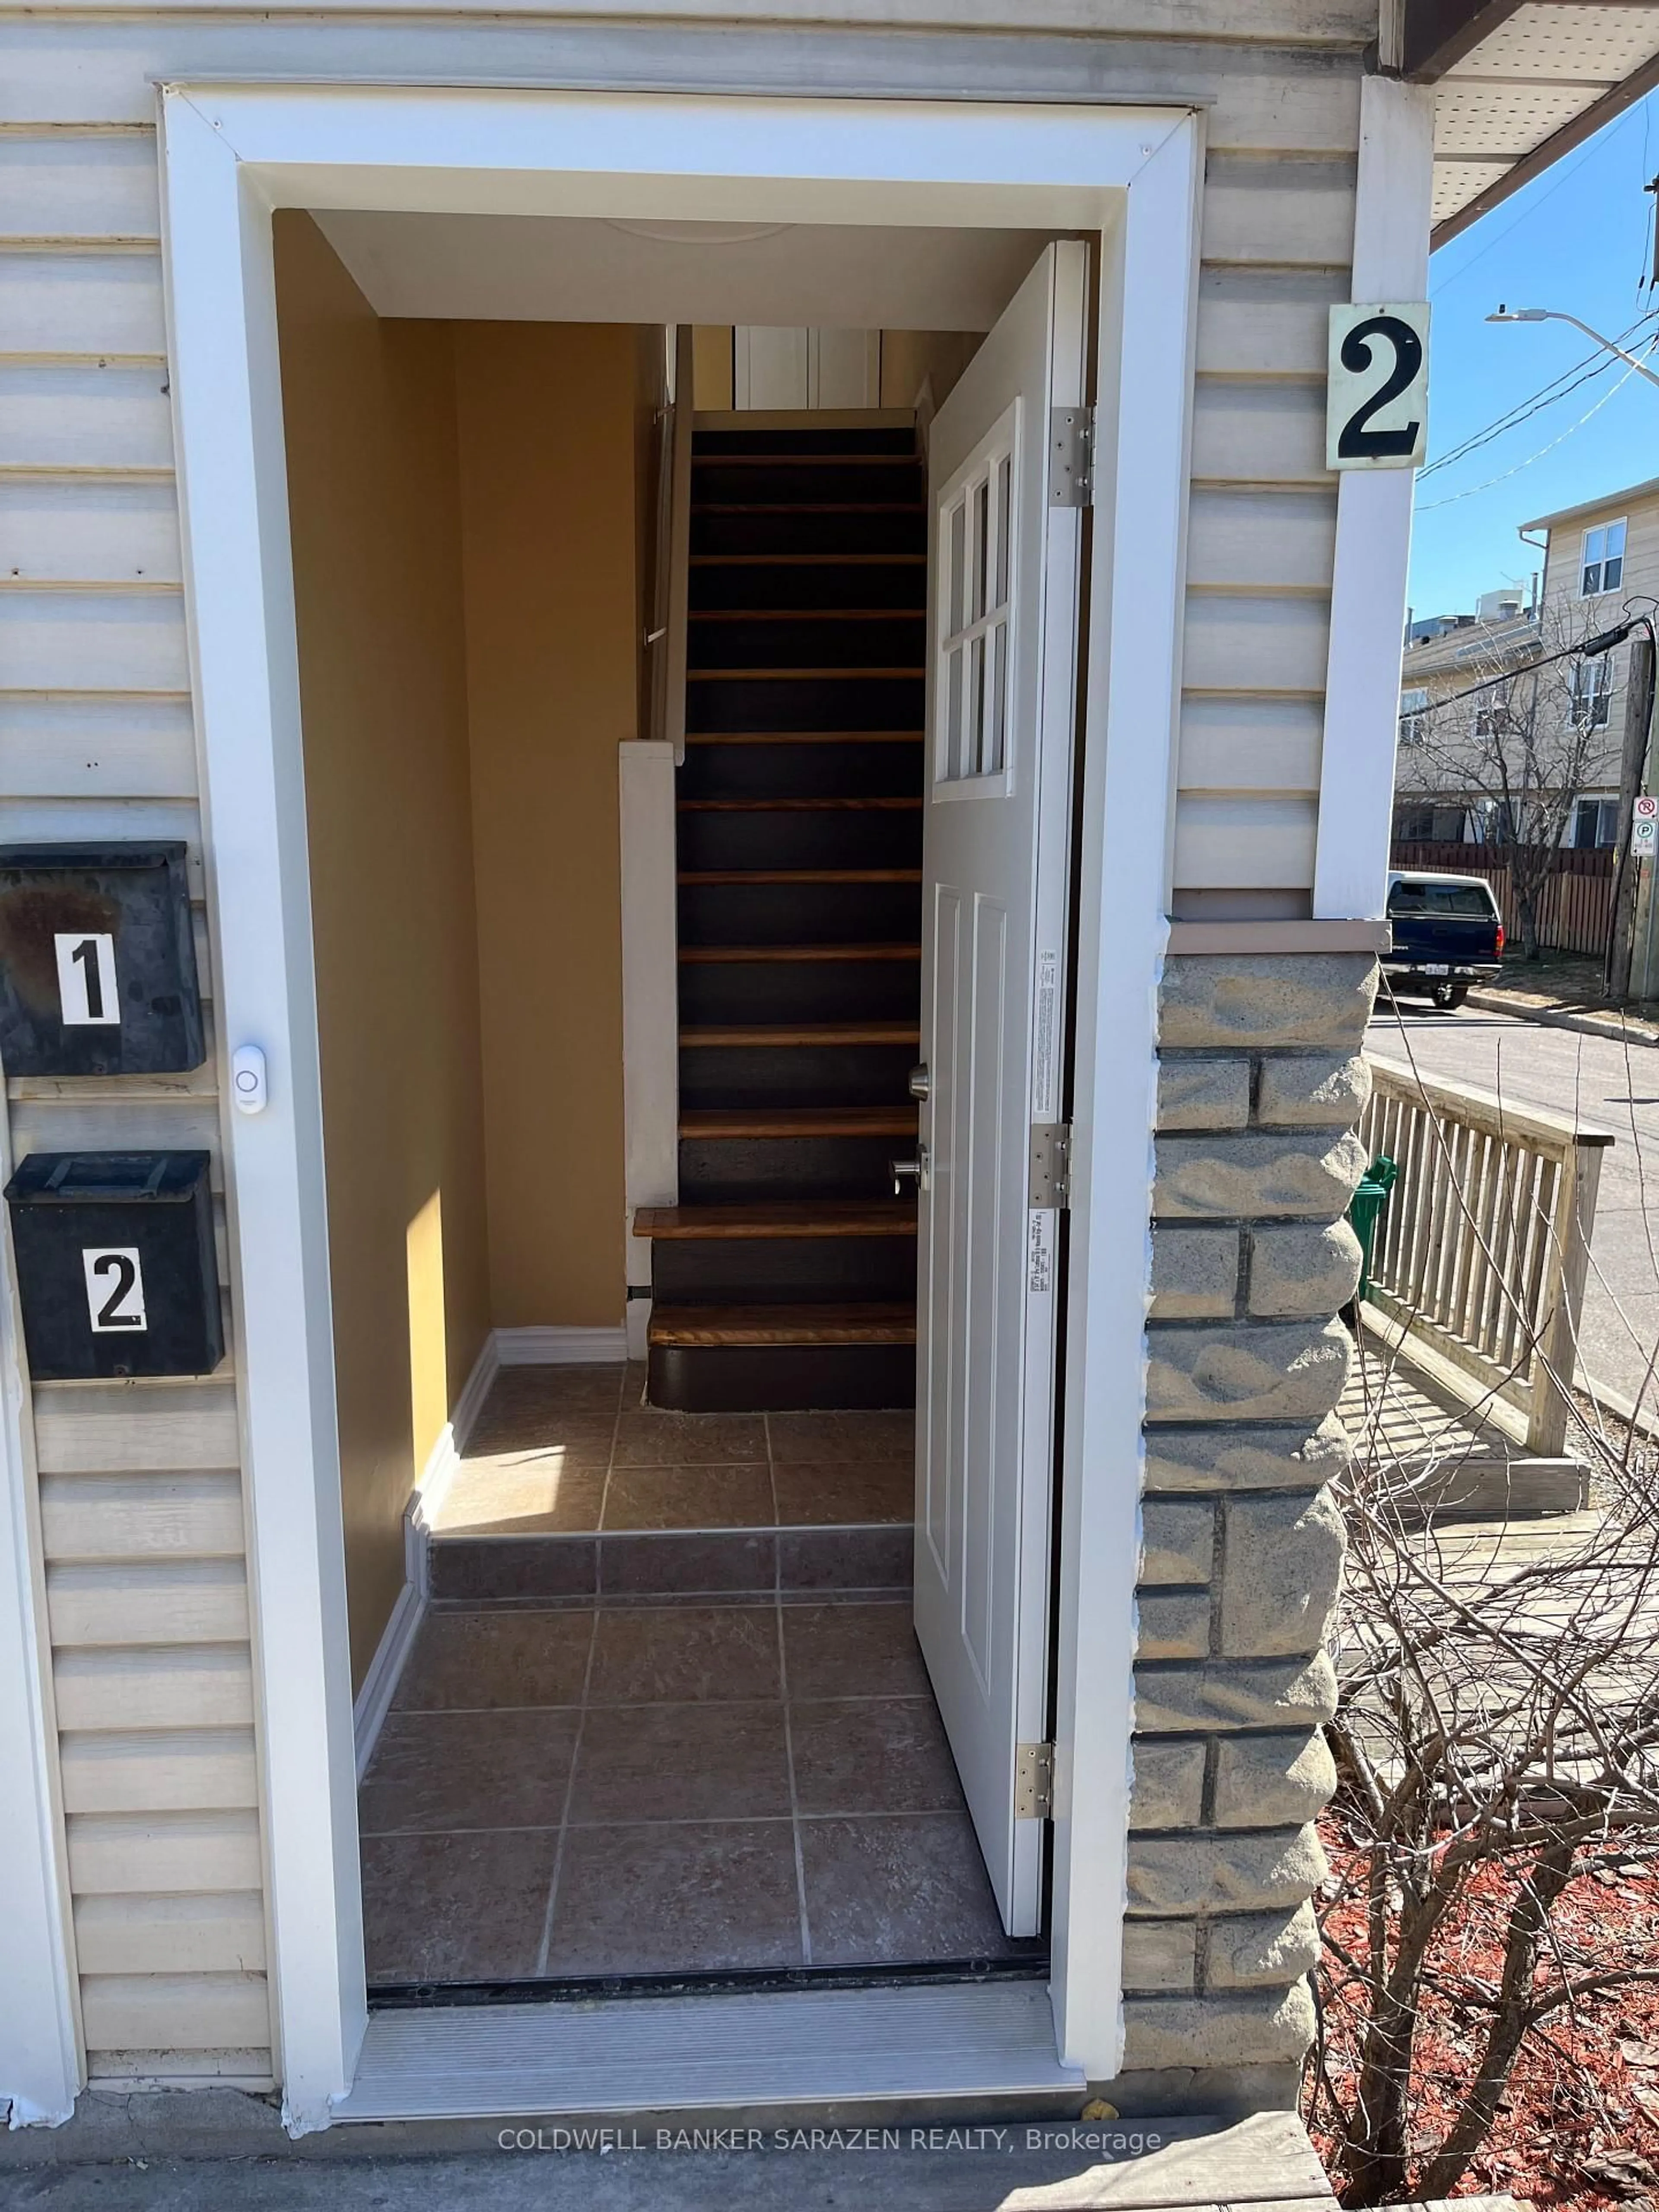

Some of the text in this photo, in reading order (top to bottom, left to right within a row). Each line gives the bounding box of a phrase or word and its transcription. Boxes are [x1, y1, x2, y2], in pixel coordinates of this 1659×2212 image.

[1338, 316, 1422, 458] 2
[1642, 826, 1649, 835] P
[72, 939, 104, 1018] 1
[94, 1255, 142, 1326] 2
